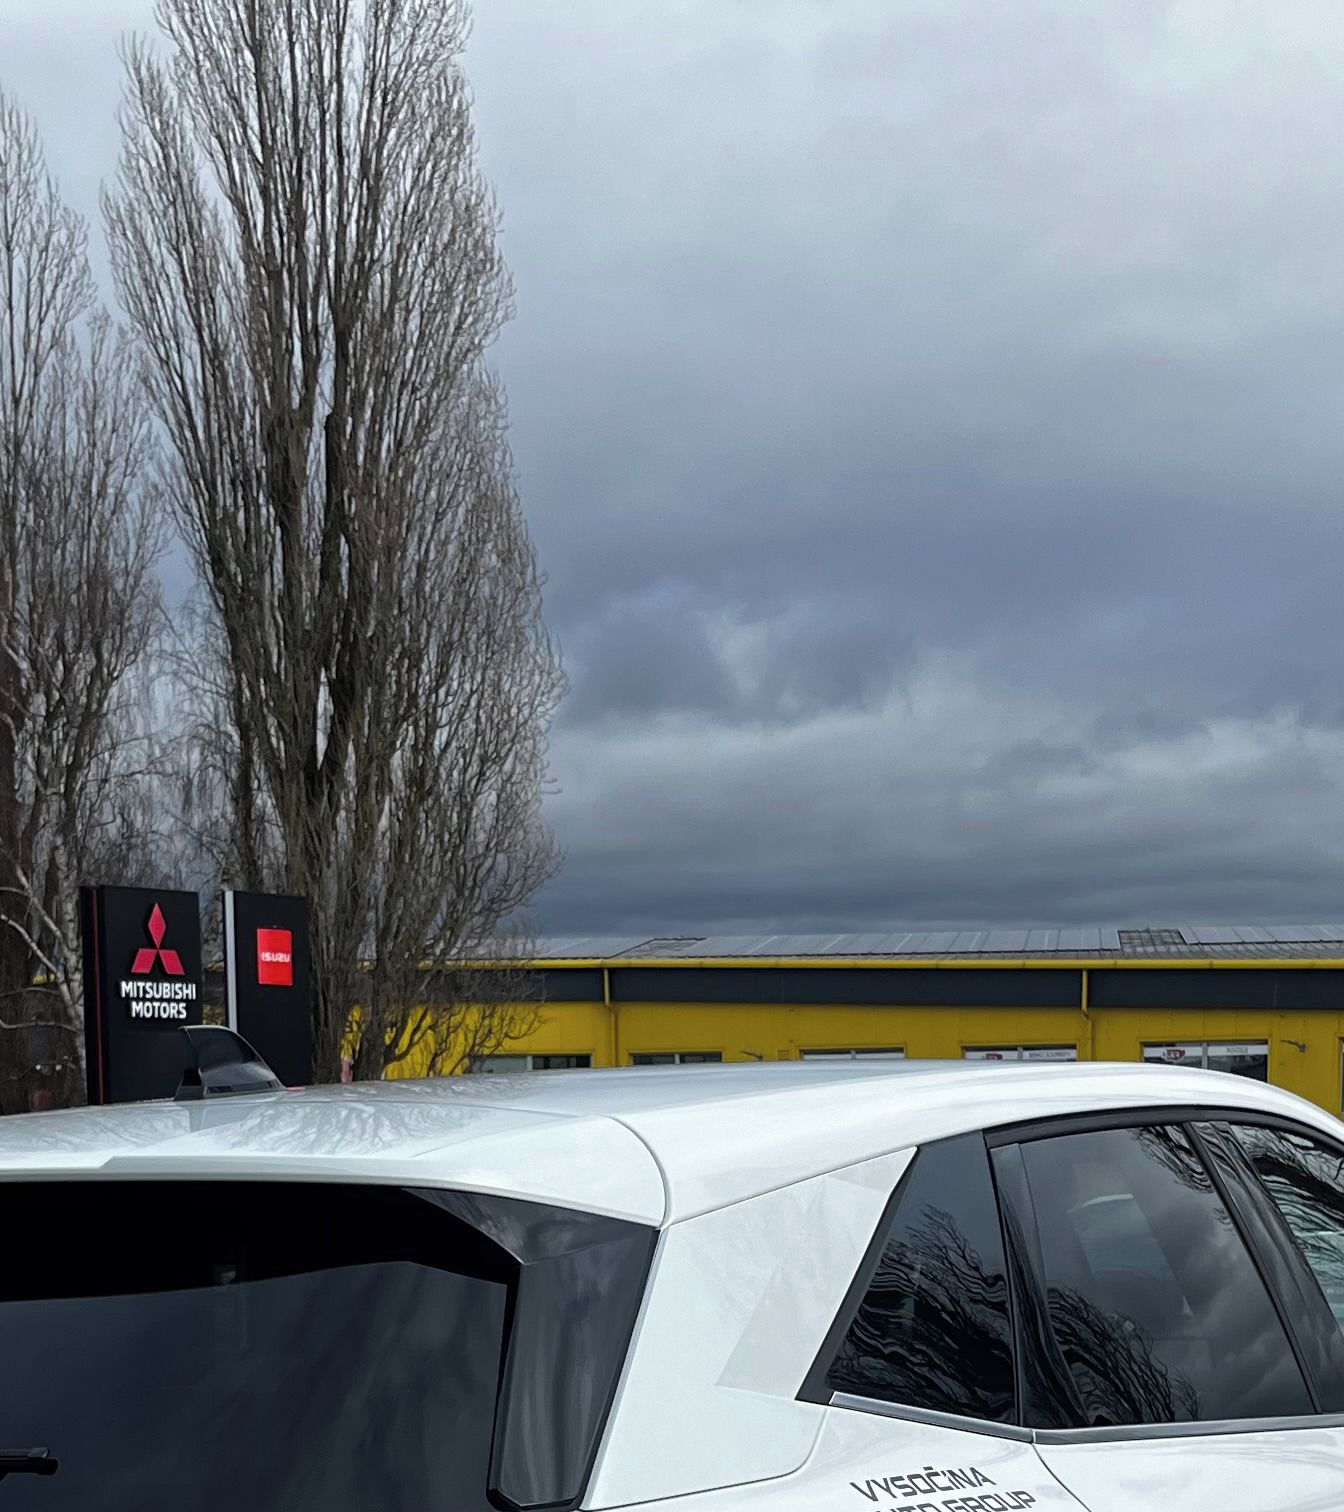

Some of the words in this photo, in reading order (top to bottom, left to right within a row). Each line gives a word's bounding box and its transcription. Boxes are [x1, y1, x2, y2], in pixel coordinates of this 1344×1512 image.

[261, 951, 290, 963] ISUZU
[120, 980, 197, 1000] MITSUBISHI
[131, 1000, 187, 1020] MOTORS
[849, 1466, 997, 1501] VYSOČINA
